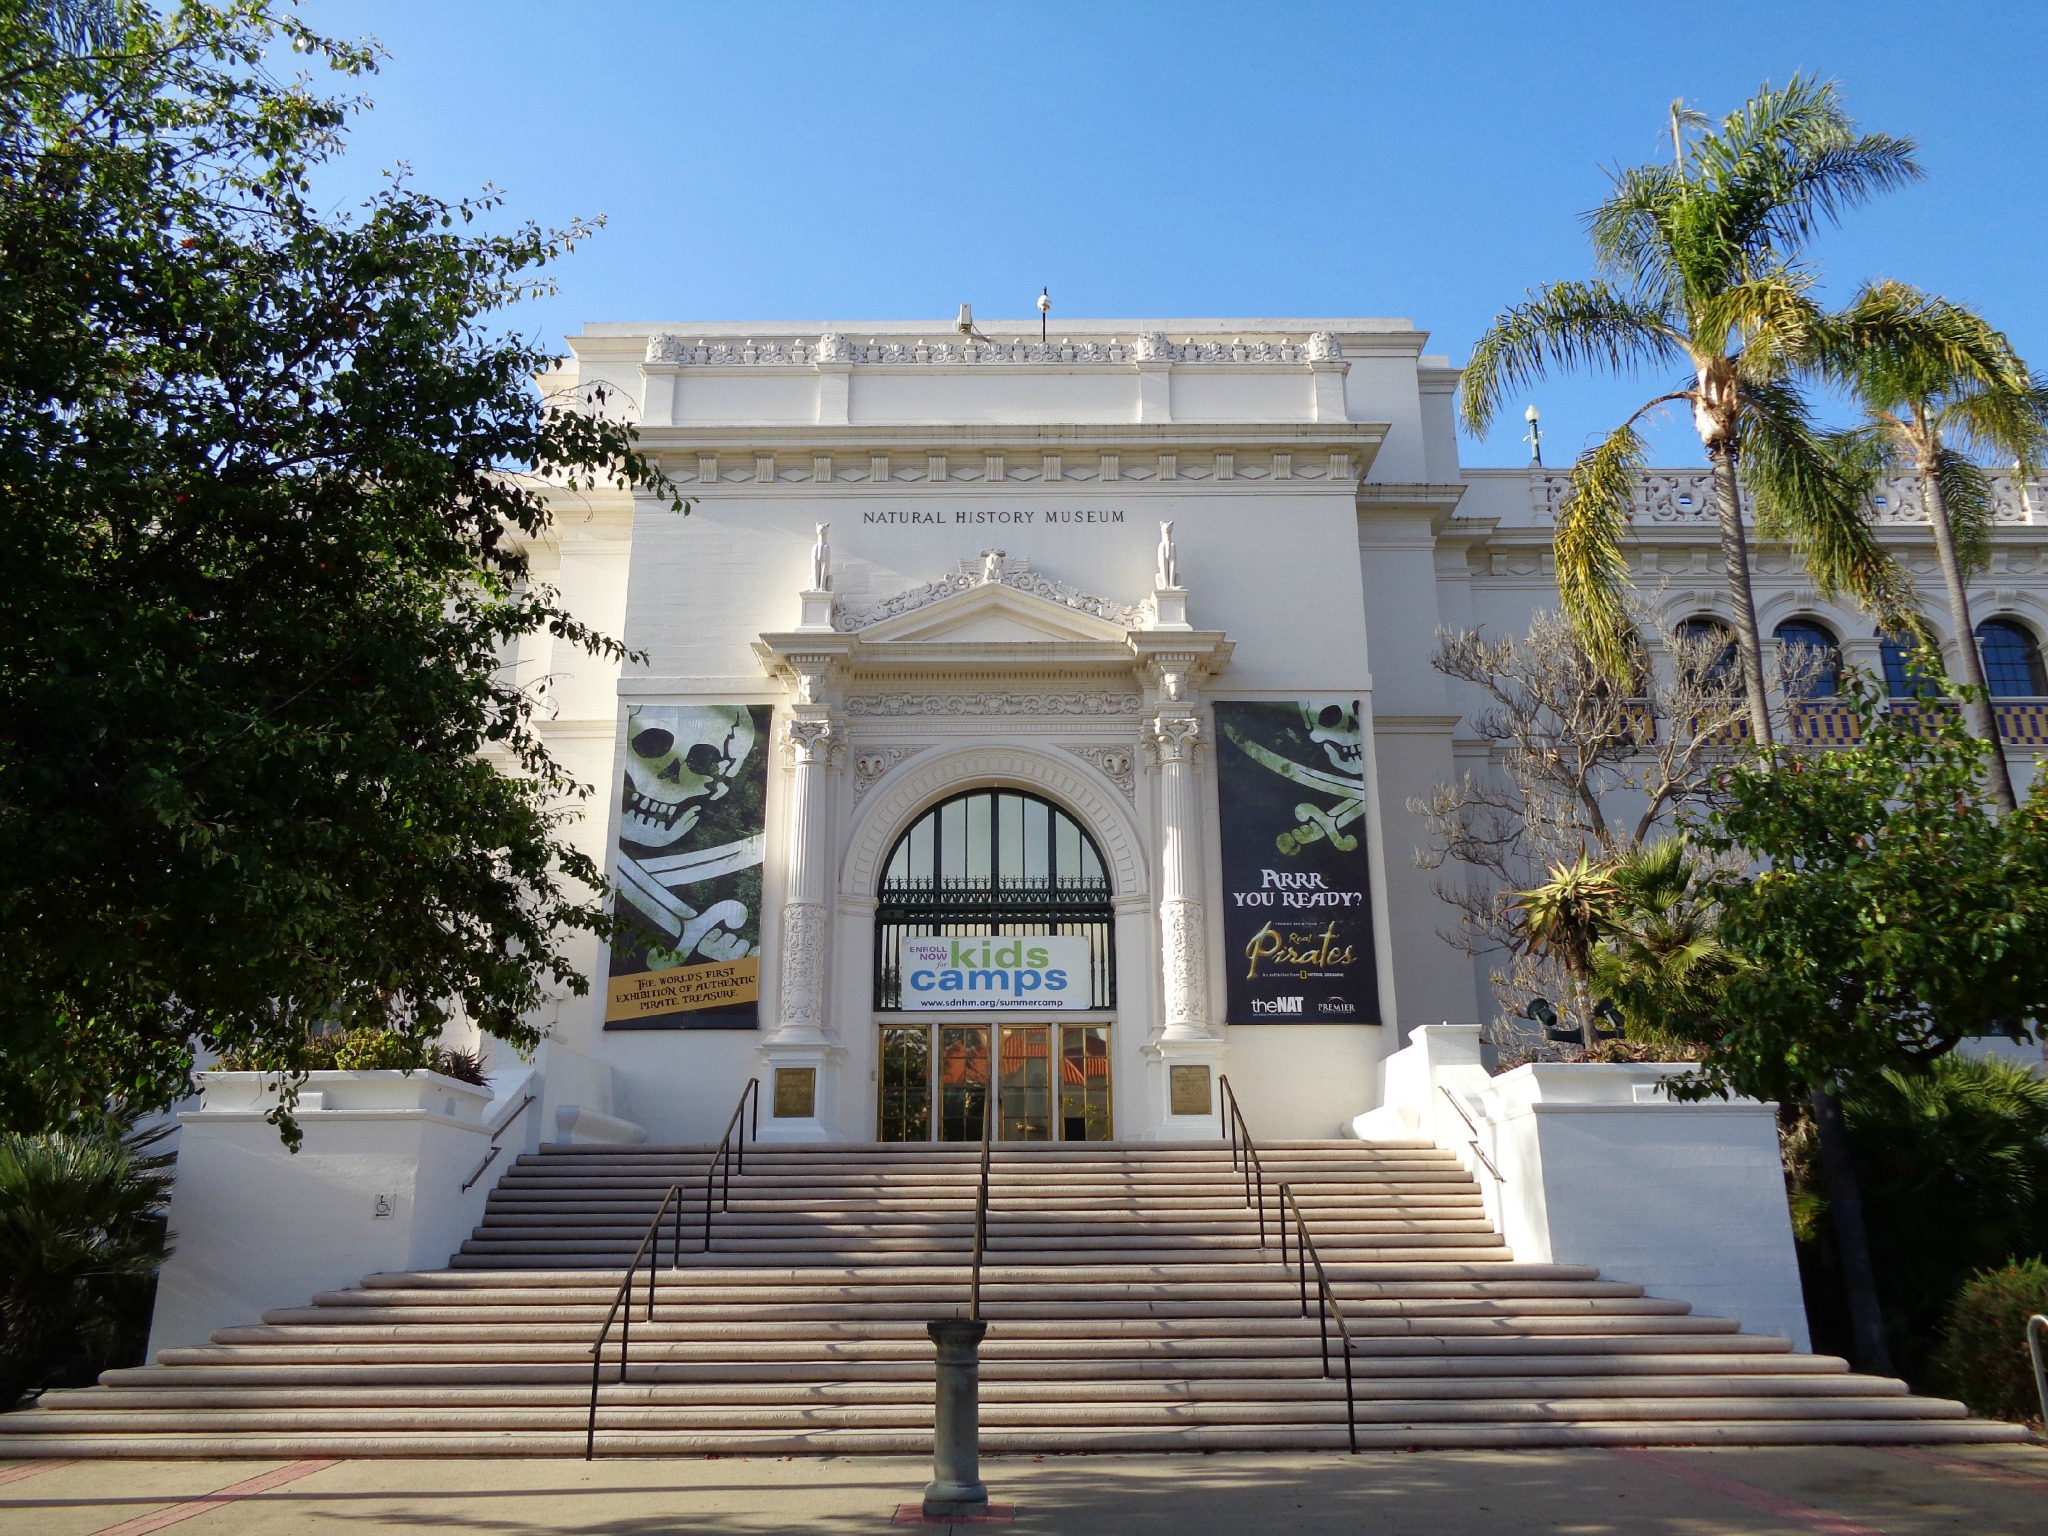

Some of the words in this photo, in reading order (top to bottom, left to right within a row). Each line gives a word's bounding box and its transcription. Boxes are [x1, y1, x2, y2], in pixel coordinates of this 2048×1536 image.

[864, 511, 946, 524] NATURAL
[956, 511, 1035, 524] HISTORY
[1045, 510, 1125, 523] MUSEUM
[1260, 869, 1329, 890] ARRR
[1232, 892, 1275, 907] YOU
[1282, 892, 1363, 909] READY?
[1288, 932, 1313, 945] Real
[919, 953, 948, 961] NOW
[951, 940, 1049, 969] kids
[1245, 920, 1357, 980] Pirates
[936, 960, 948, 970] for
[634, 978, 657, 991] THE
[659, 971, 703, 984] WORLD'S
[705, 967, 736, 978] FIRST
[910, 969, 1068, 997] camps
[615, 986, 678, 1003] EXHIBITION
[678, 984, 693, 993] OF
[694, 975, 757, 992] AUTHENTIC
[639, 997, 680, 1010] PIRATE
[681, 989, 739, 1004] TREASURE
[920, 998, 1064, 1009] www.sdnhm.org/summercamp
[1318, 1003, 1356, 1011] PREMIER
